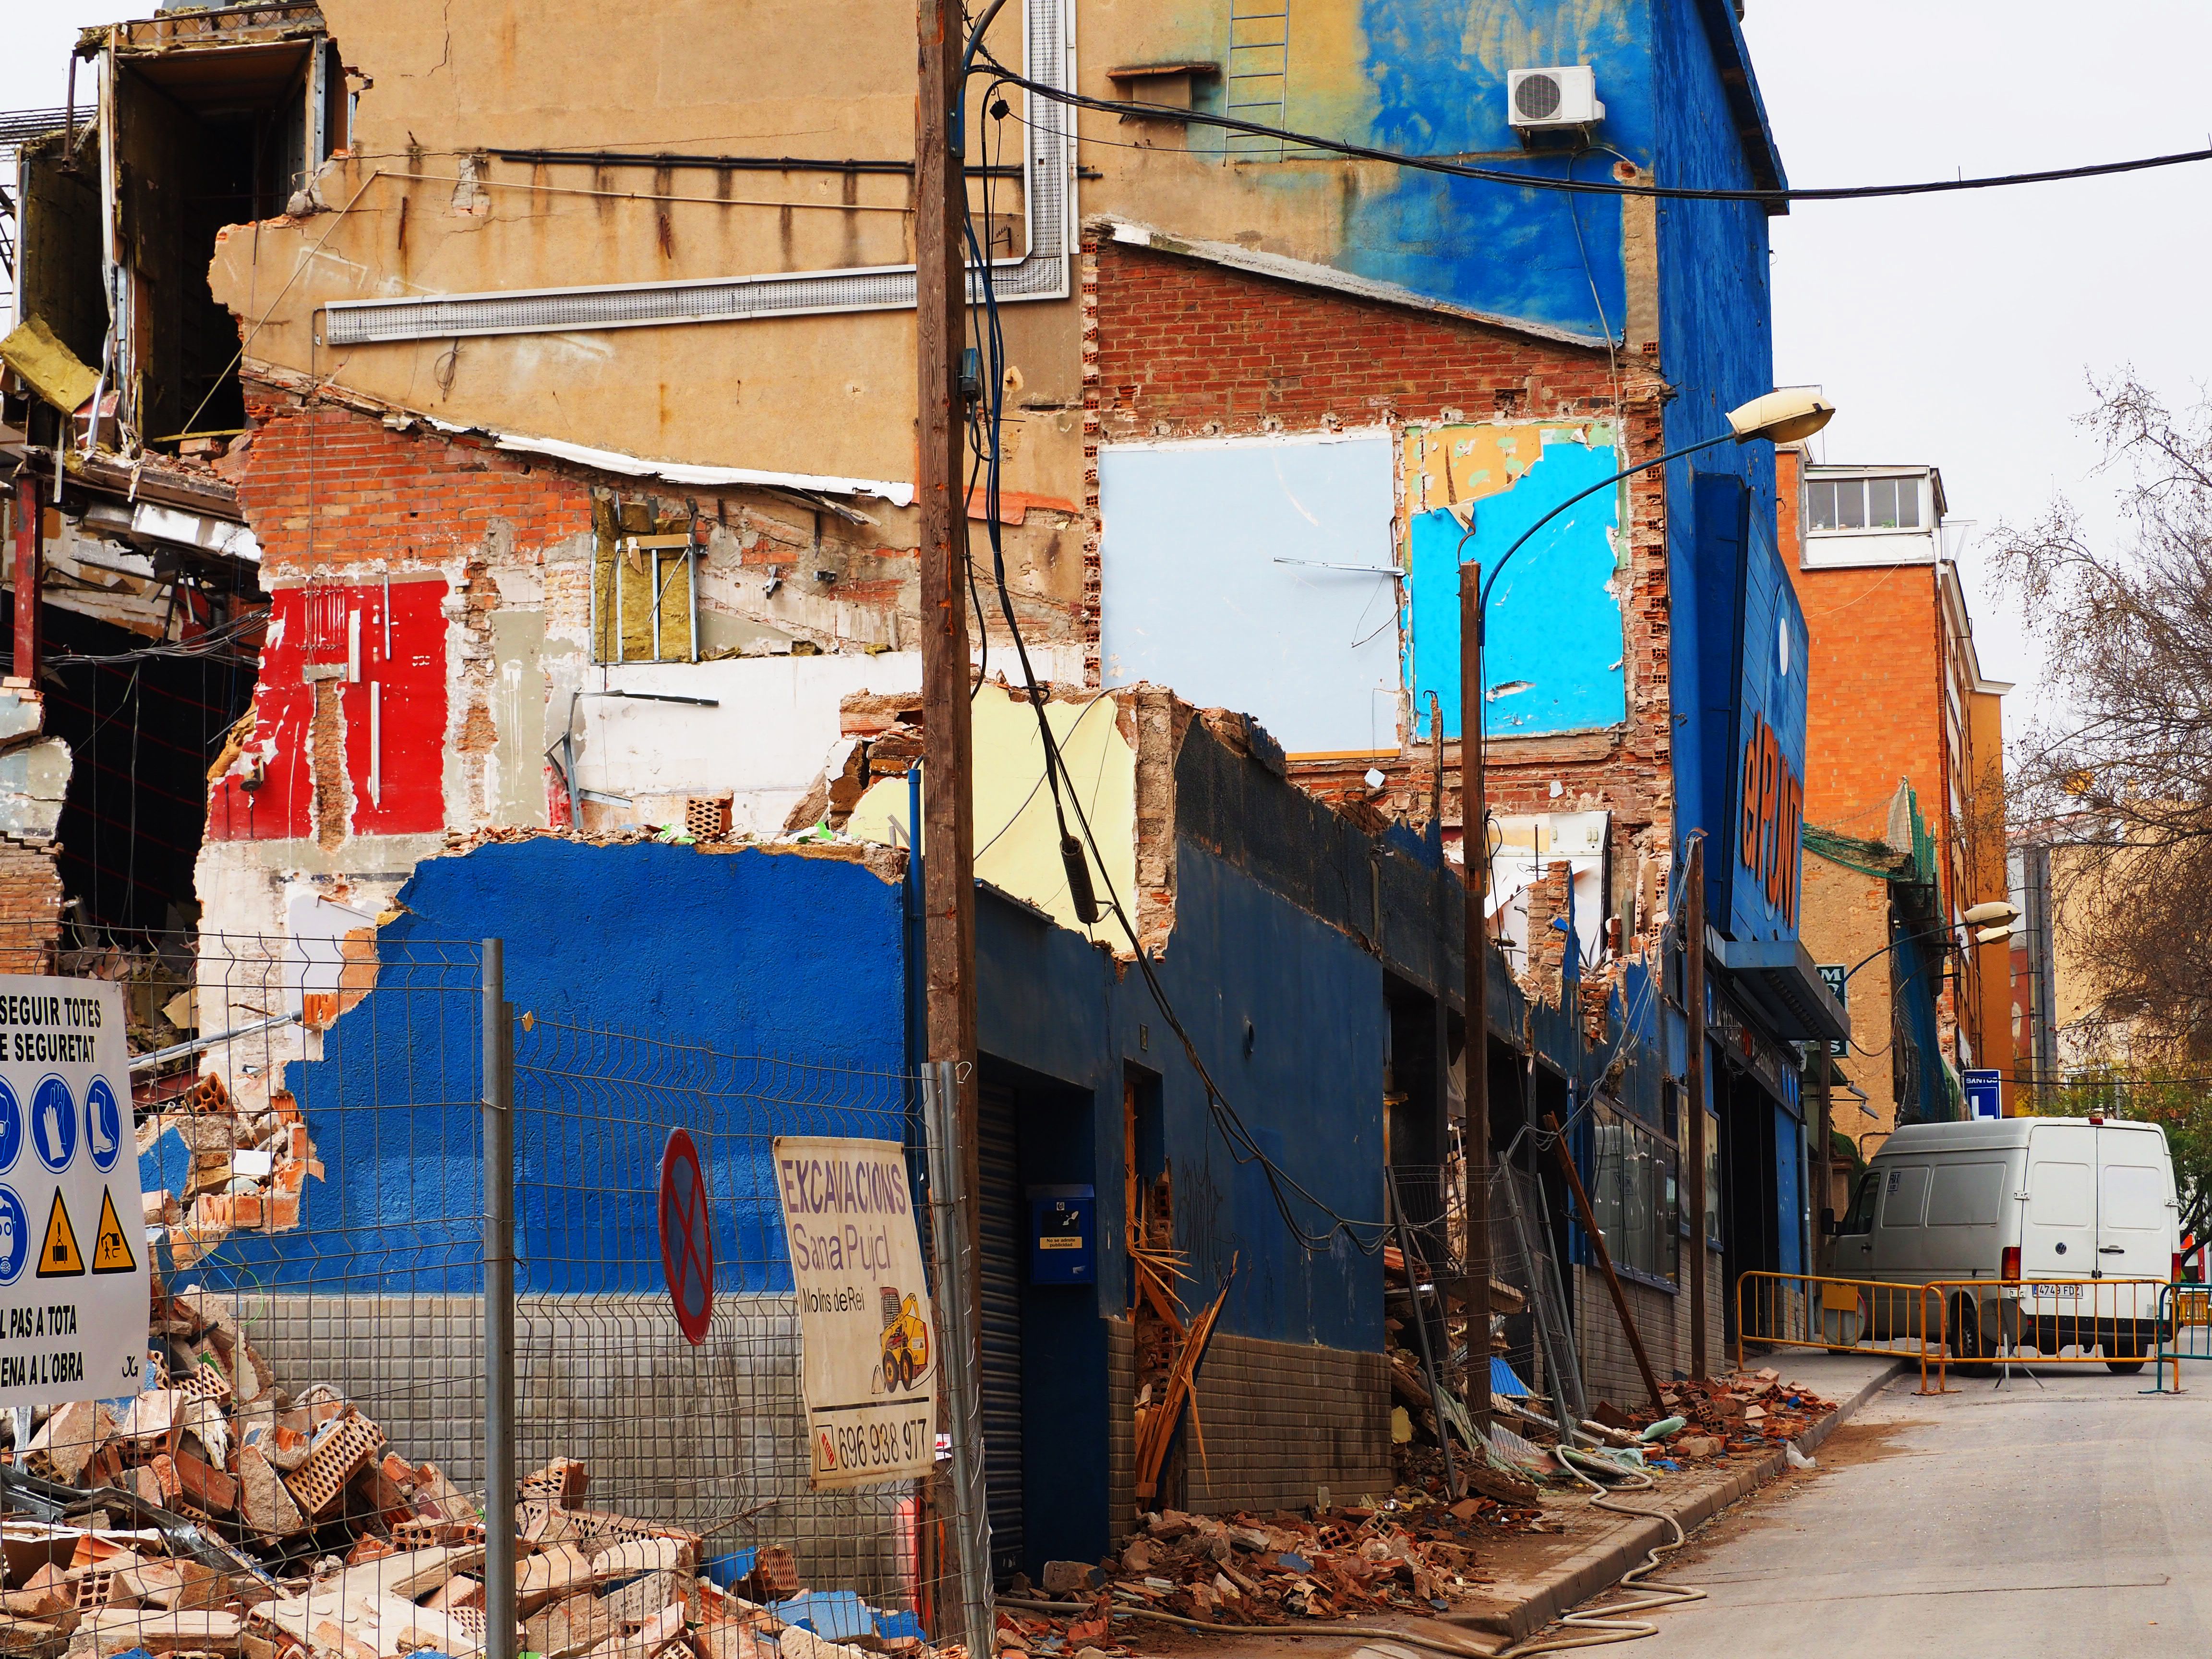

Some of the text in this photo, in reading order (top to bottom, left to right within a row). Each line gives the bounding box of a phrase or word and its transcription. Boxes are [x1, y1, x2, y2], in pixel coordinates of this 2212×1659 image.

[0, 995, 101, 1028] SEGUIR TOTES
[15, 1033, 95, 1062] SEGURETAT
[781, 1160, 906, 1214] EXCAVACIONS
[793, 1223, 843, 1271] Sana
[803, 1286, 865, 1313] Molins de Rei
[10, 1307, 32, 1338] PAS
[36, 1307, 44, 1336] A
[48, 1305, 77, 1335] TOTA
[29, 1355, 37, 1385] A
[839, 1419, 926, 1469] 696 938 977
